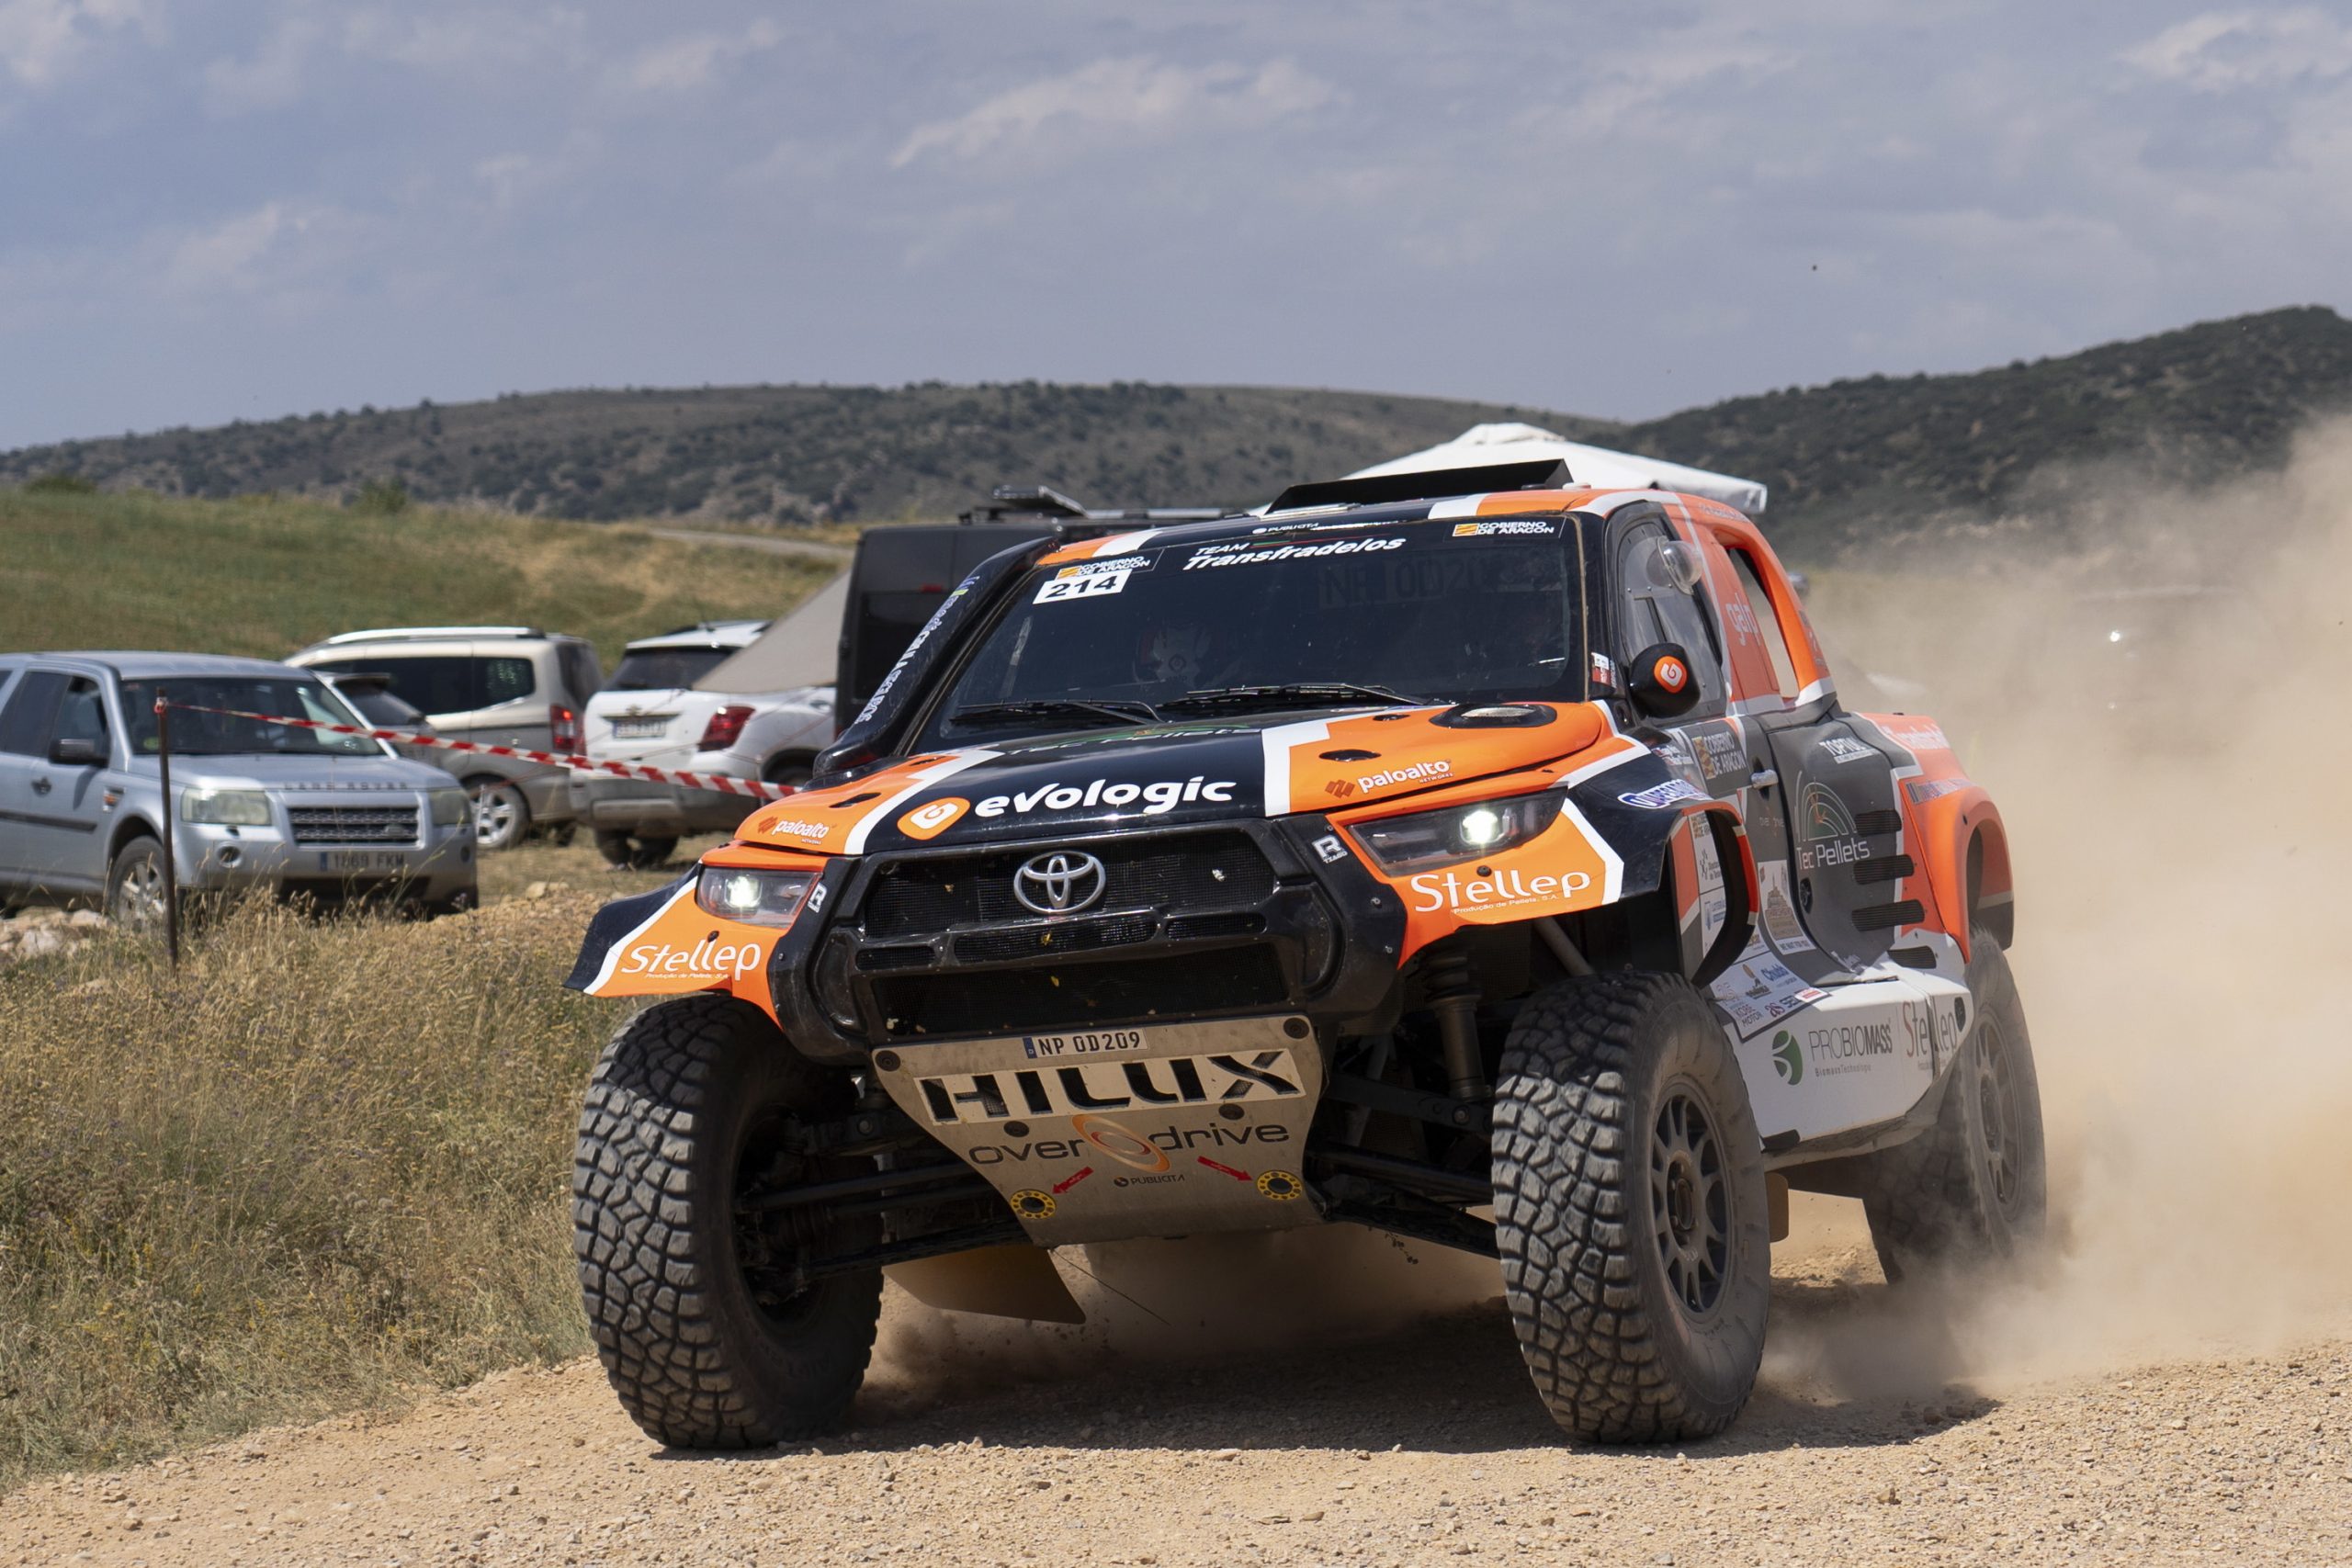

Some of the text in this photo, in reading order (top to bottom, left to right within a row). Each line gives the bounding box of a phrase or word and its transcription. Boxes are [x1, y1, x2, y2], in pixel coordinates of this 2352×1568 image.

[1479, 521, 1547, 529] GOBIERNO
[1080, 556, 1145, 570] GOBIERNO
[1182, 537, 1407, 570] Transfradelos
[1195, 542, 1250, 557] TEAM
[1045, 575, 1119, 599] 214
[1358, 761, 1450, 794] paloalto
[975, 776, 1237, 818] evologic
[772, 820, 830, 839] paloalto
[1796, 838, 1871, 870] Tec Pellets
[1410, 869, 1591, 912] Stellep
[621, 939, 762, 981] Stellep
[1038, 1037, 1065, 1055] NP
[1808, 1023, 1893, 1062] PROBIOMASS
[920, 1050, 1301, 1122] HILUX
[968, 1122, 1291, 1165] over drive
[1131, 1174, 1186, 1185] PUBLICITA
